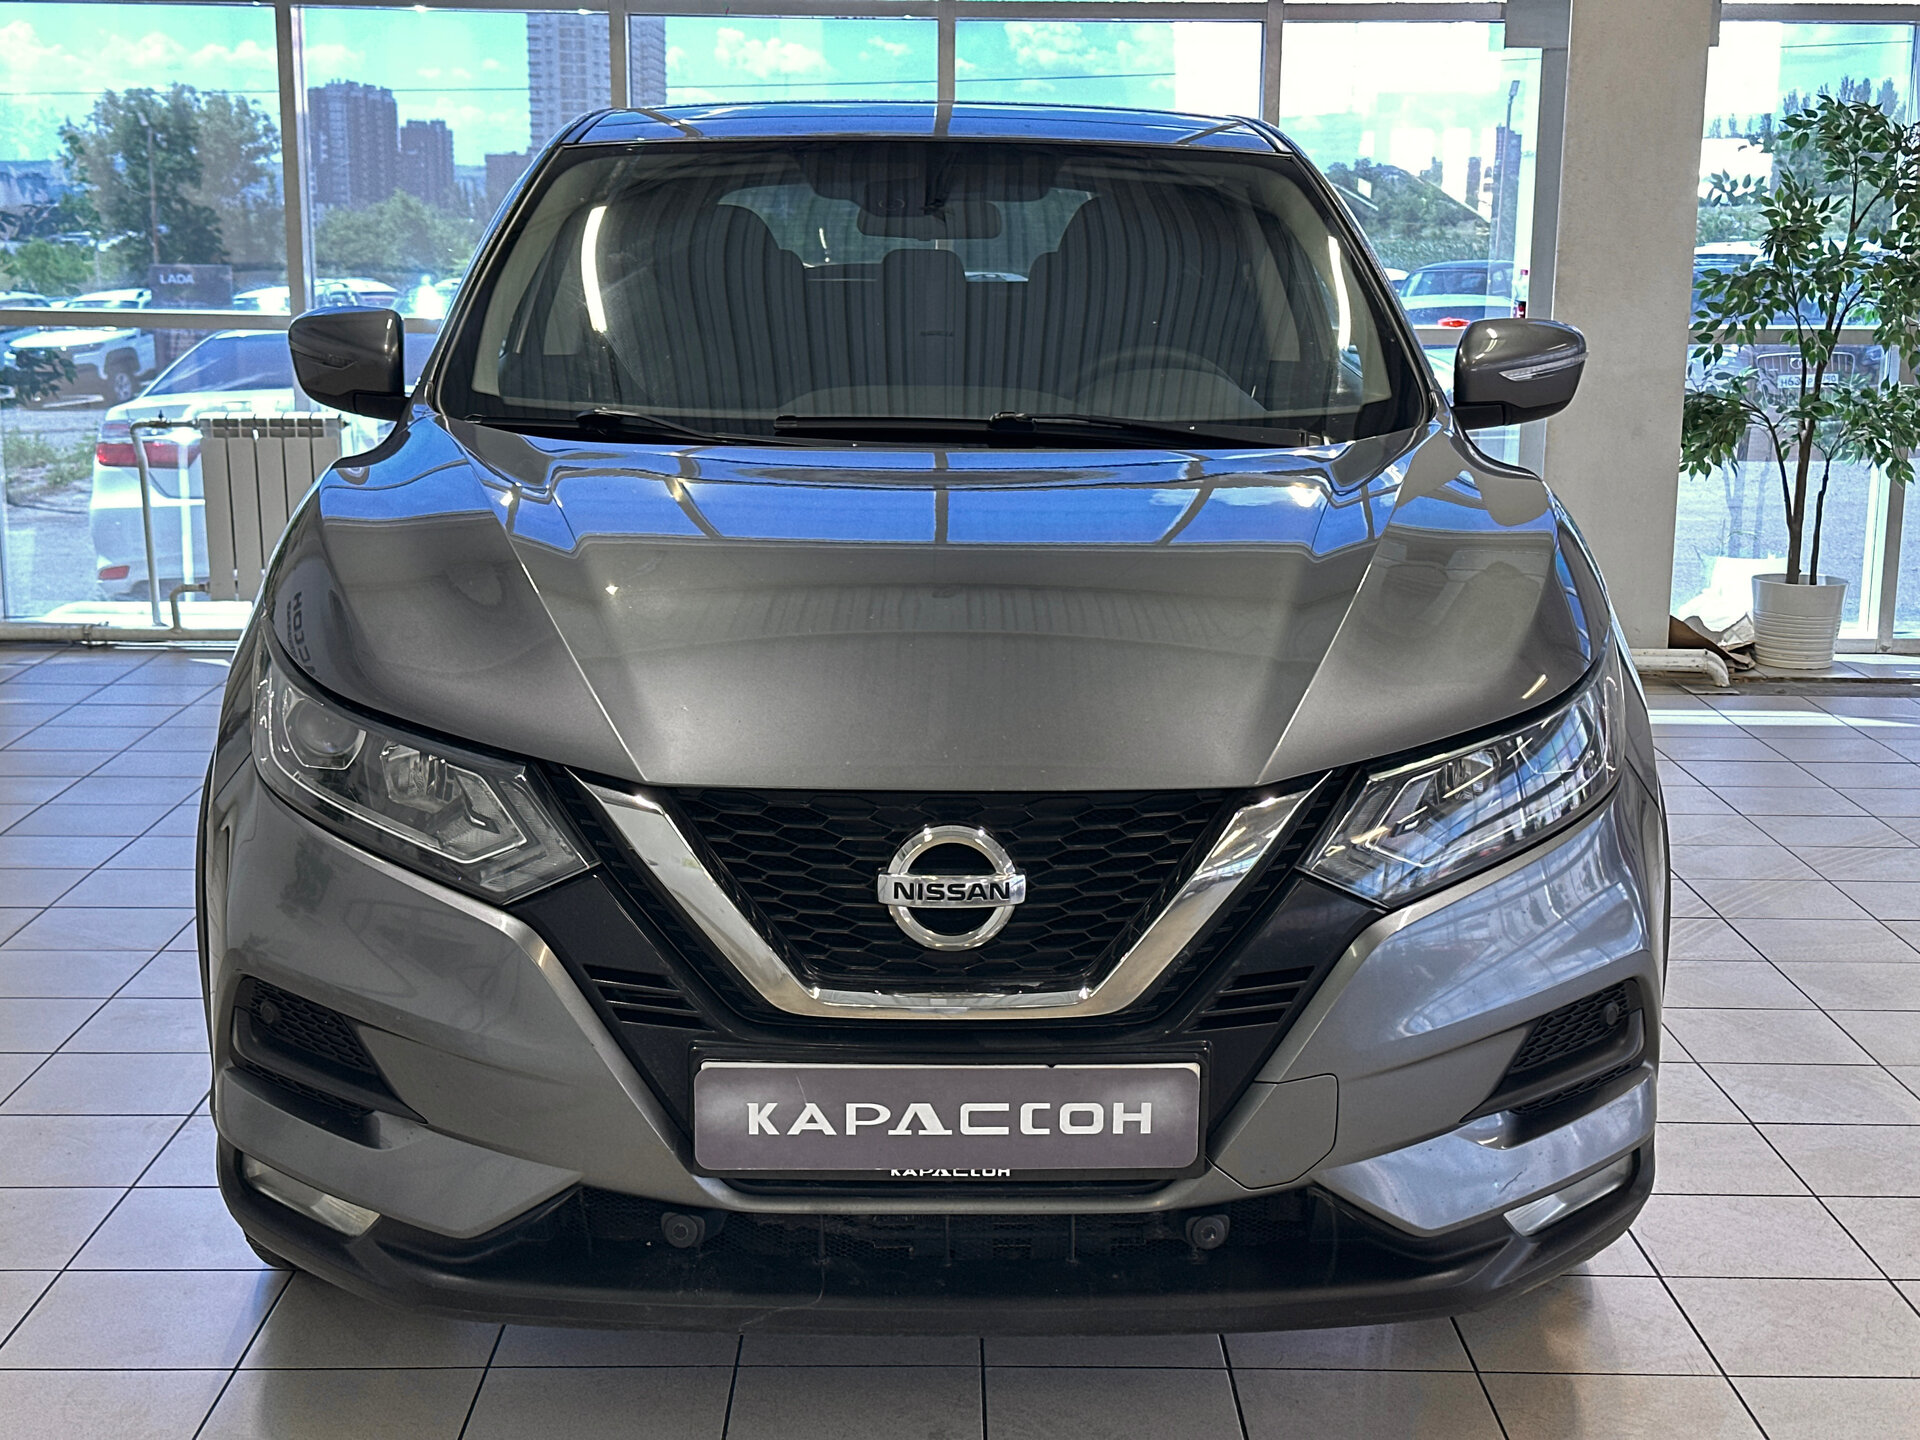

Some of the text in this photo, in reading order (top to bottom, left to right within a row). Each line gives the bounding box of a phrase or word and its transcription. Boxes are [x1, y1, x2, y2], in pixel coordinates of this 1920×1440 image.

[159, 273, 195, 284] LADA
[893, 881, 1010, 901] NISSAN
[746, 1102, 1152, 1136] КАРАССОН
